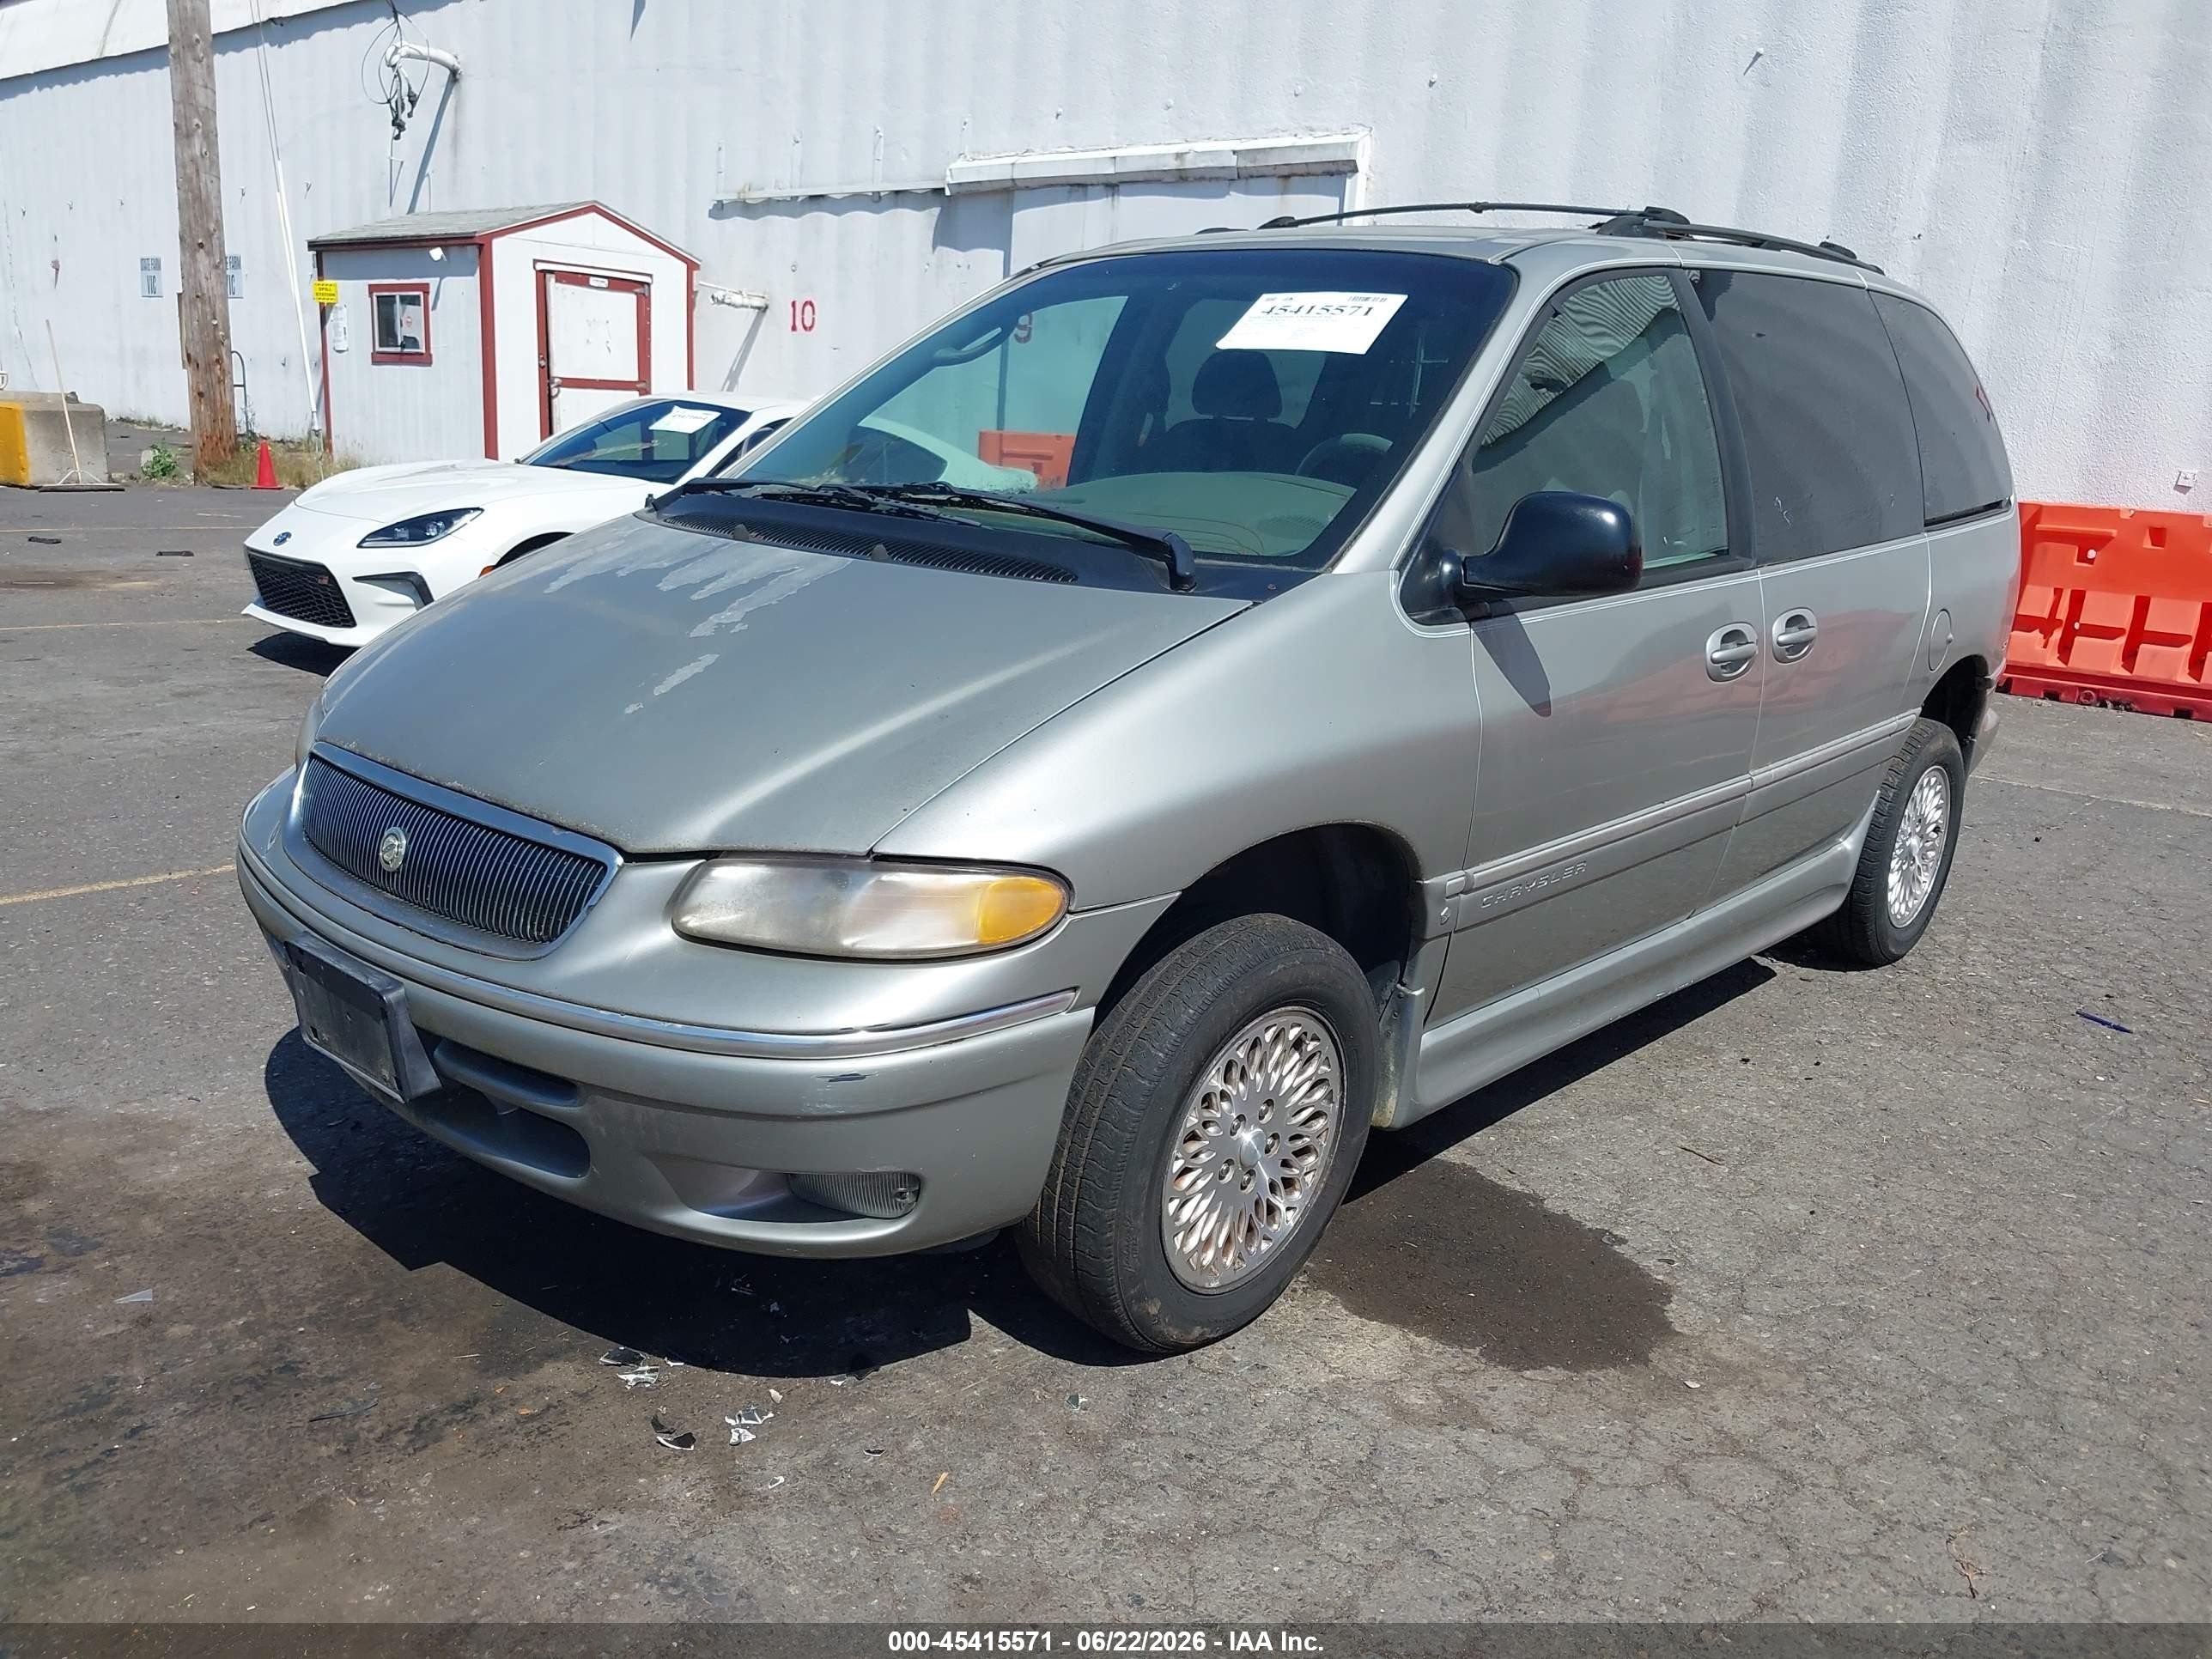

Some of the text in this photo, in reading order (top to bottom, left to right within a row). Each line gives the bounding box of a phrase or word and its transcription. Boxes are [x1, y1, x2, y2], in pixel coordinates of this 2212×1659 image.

[146, 274, 156, 295] VIC
[226, 274, 236, 295] IC
[791, 301, 815, 331] 10
[1261, 305, 1375, 317] 45415571
[1014, 314, 1032, 344] 9
[1480, 860, 1588, 909] CHRYSLER
